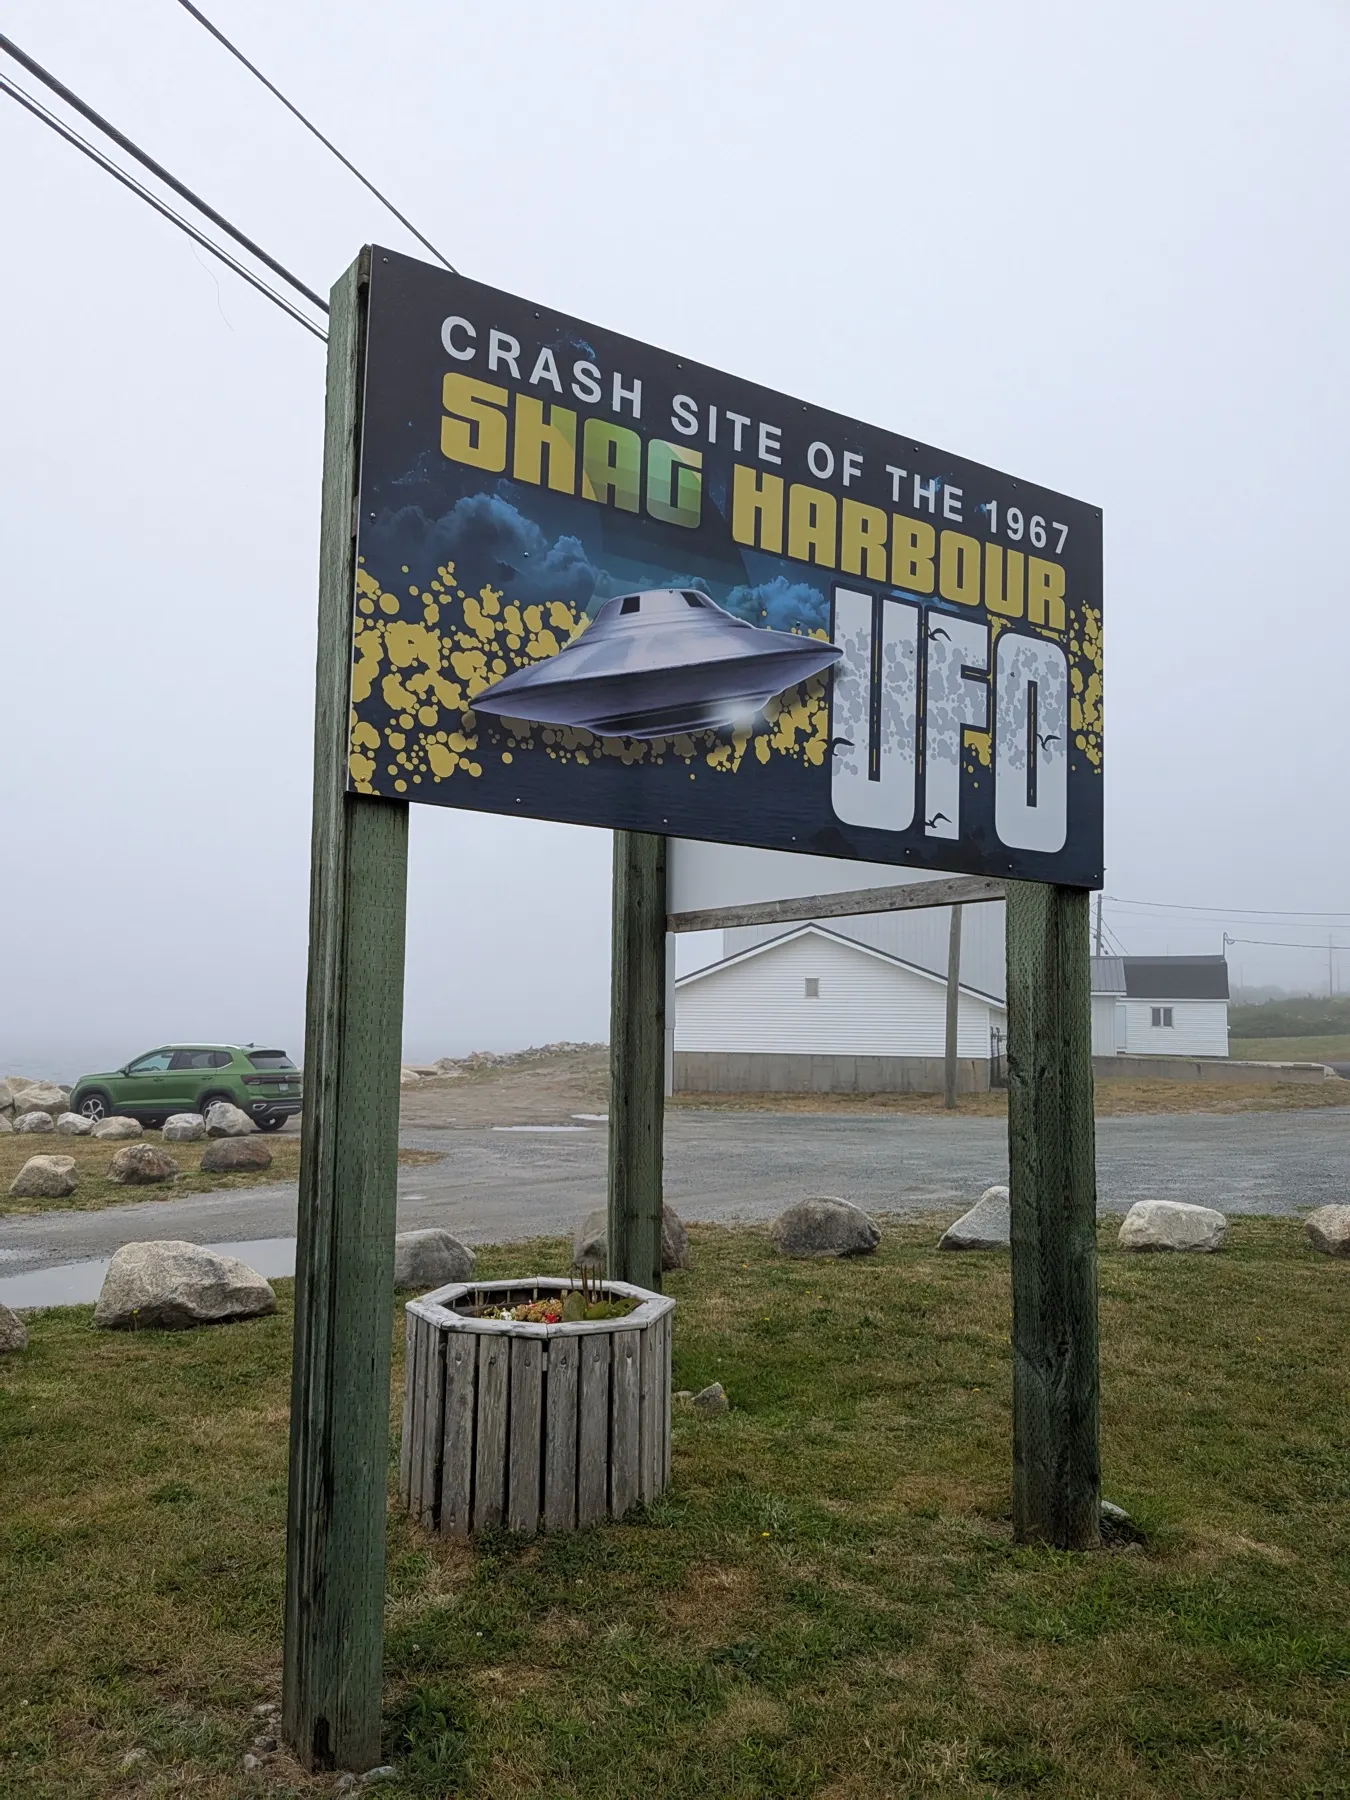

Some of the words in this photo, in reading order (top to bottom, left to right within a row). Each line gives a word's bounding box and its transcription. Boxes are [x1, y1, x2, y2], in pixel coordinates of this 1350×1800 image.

[440, 315, 642, 419] CRASH
[670, 394, 782, 465] SITE
[807, 441, 864, 487] OF
[886, 464, 963, 522] THE
[986, 500, 1069, 554] 1967
[440, 372, 703, 529] SHAG
[732, 463, 1066, 631] HARBOUR
[831, 586, 1068, 854] UFO
